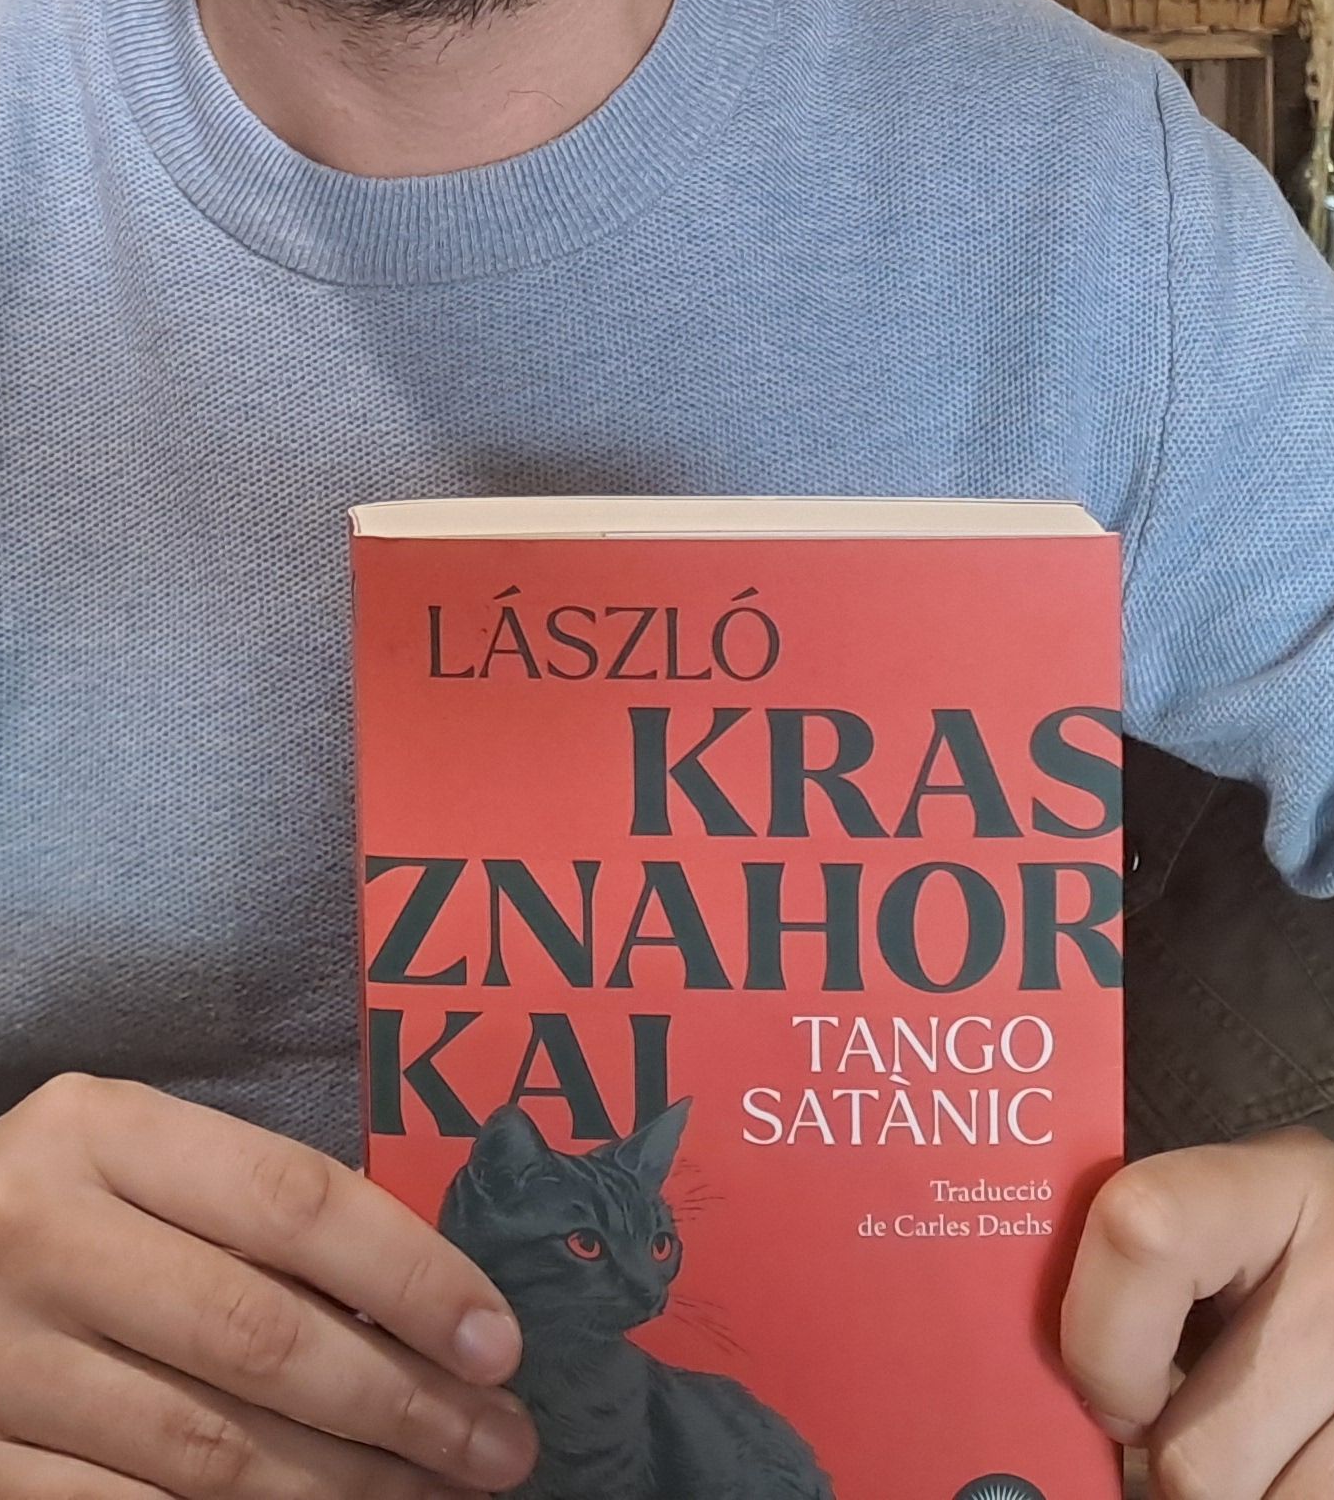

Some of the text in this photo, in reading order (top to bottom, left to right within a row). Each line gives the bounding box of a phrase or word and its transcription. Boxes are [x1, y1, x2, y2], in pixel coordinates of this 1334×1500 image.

[426, 584, 782, 683] LÁSZLÓ
[628, 705, 1124, 840] KRAS
[364, 854, 1124, 994] ZNAHOR
[368, 1007, 672, 1140] KAI
[791, 1013, 1055, 1074] TANGO
[742, 1073, 1054, 1148] SATÀNIC
[857, 1212, 1054, 1238] de Carles Dachs
[929, 1178, 1053, 1203] Traducció
